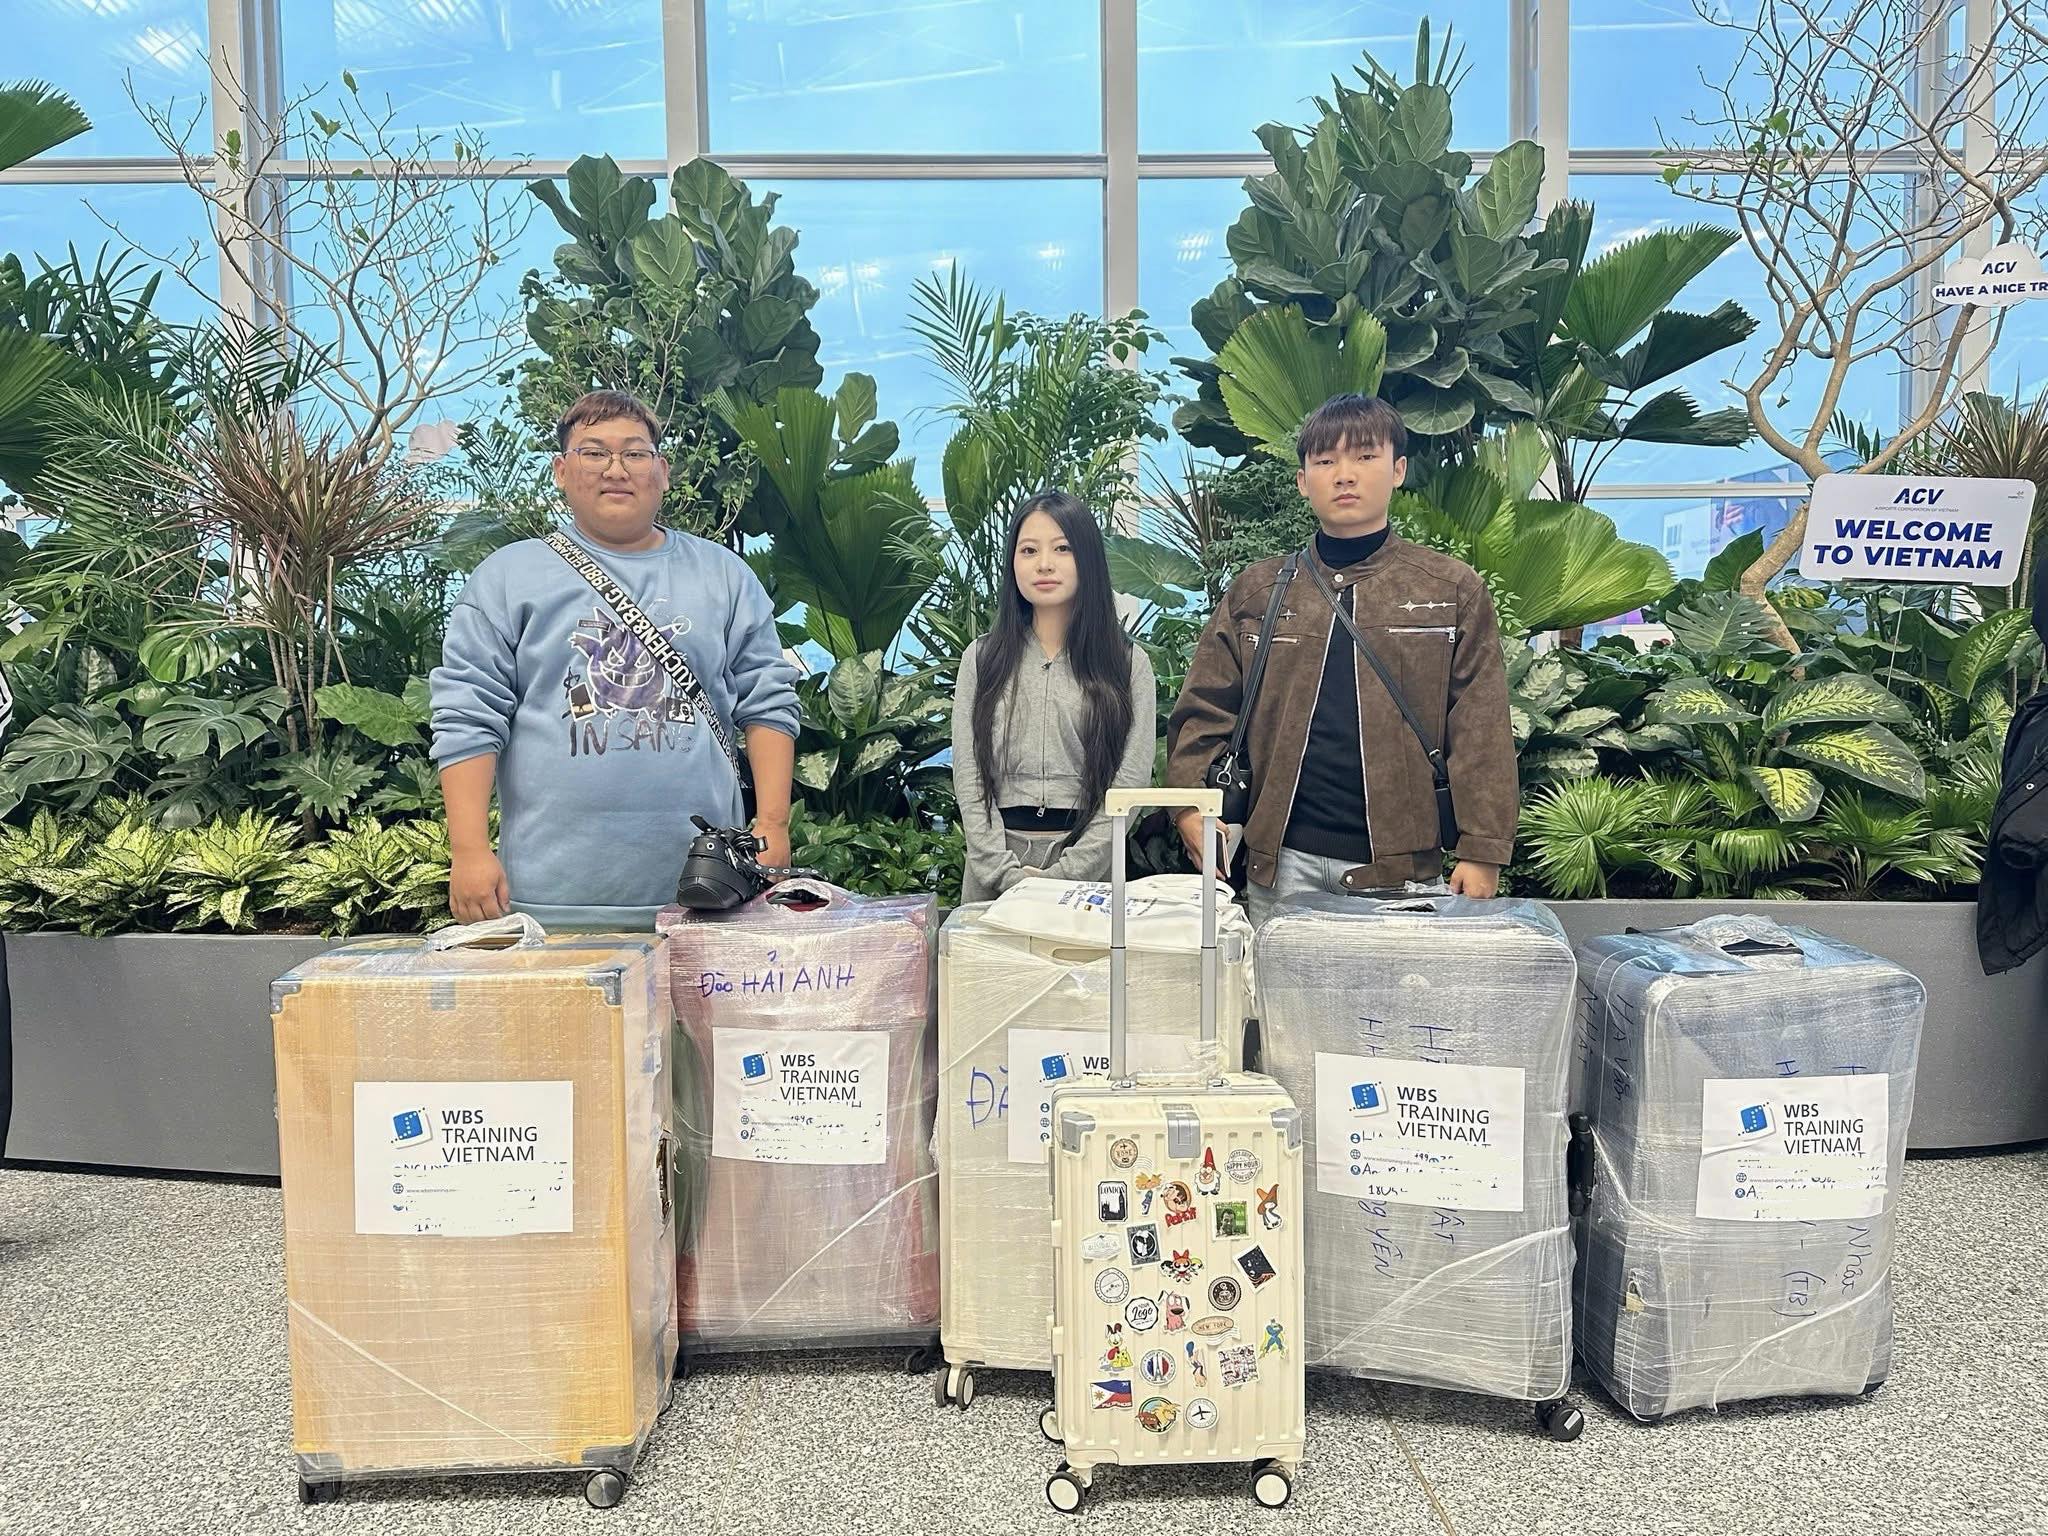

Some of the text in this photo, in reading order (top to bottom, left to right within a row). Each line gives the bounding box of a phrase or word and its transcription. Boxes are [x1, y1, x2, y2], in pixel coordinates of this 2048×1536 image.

[1981, 261, 2017, 275] ACV
[1936, 286, 1974, 297] HAVE
[1978, 285, 1988, 295] A
[1993, 283, 2026, 294] NICE
[1893, 488, 1944, 505] ACV
[1835, 519, 1992, 543] WELCOME
[1814, 545, 2003, 569] TO VIETNAM
[792, 964, 855, 992] ANH
[780, 1054, 816, 1067] WBS
[1083, 1056, 1110, 1070] WB
[780, 1069, 860, 1084] TRAINING
[780, 1086, 856, 1101] VIETNAM
[1397, 1086, 1438, 1103] WBS
[441, 1110, 484, 1125] WBS
[1397, 1103, 1490, 1125] TRAINING
[1784, 1103, 1819, 1118] WBS
[441, 1126, 538, 1144] TRAINING
[1397, 1121, 1486, 1143] VIETNAM
[1784, 1118, 1864, 1137] TRAINING
[441, 1146, 535, 1163] VIETNAM
[1784, 1137, 1861, 1155] VIETNAM
[1101, 1186, 1125, 1194] LONDON
[1131, 1306, 1153, 1323] Logo
